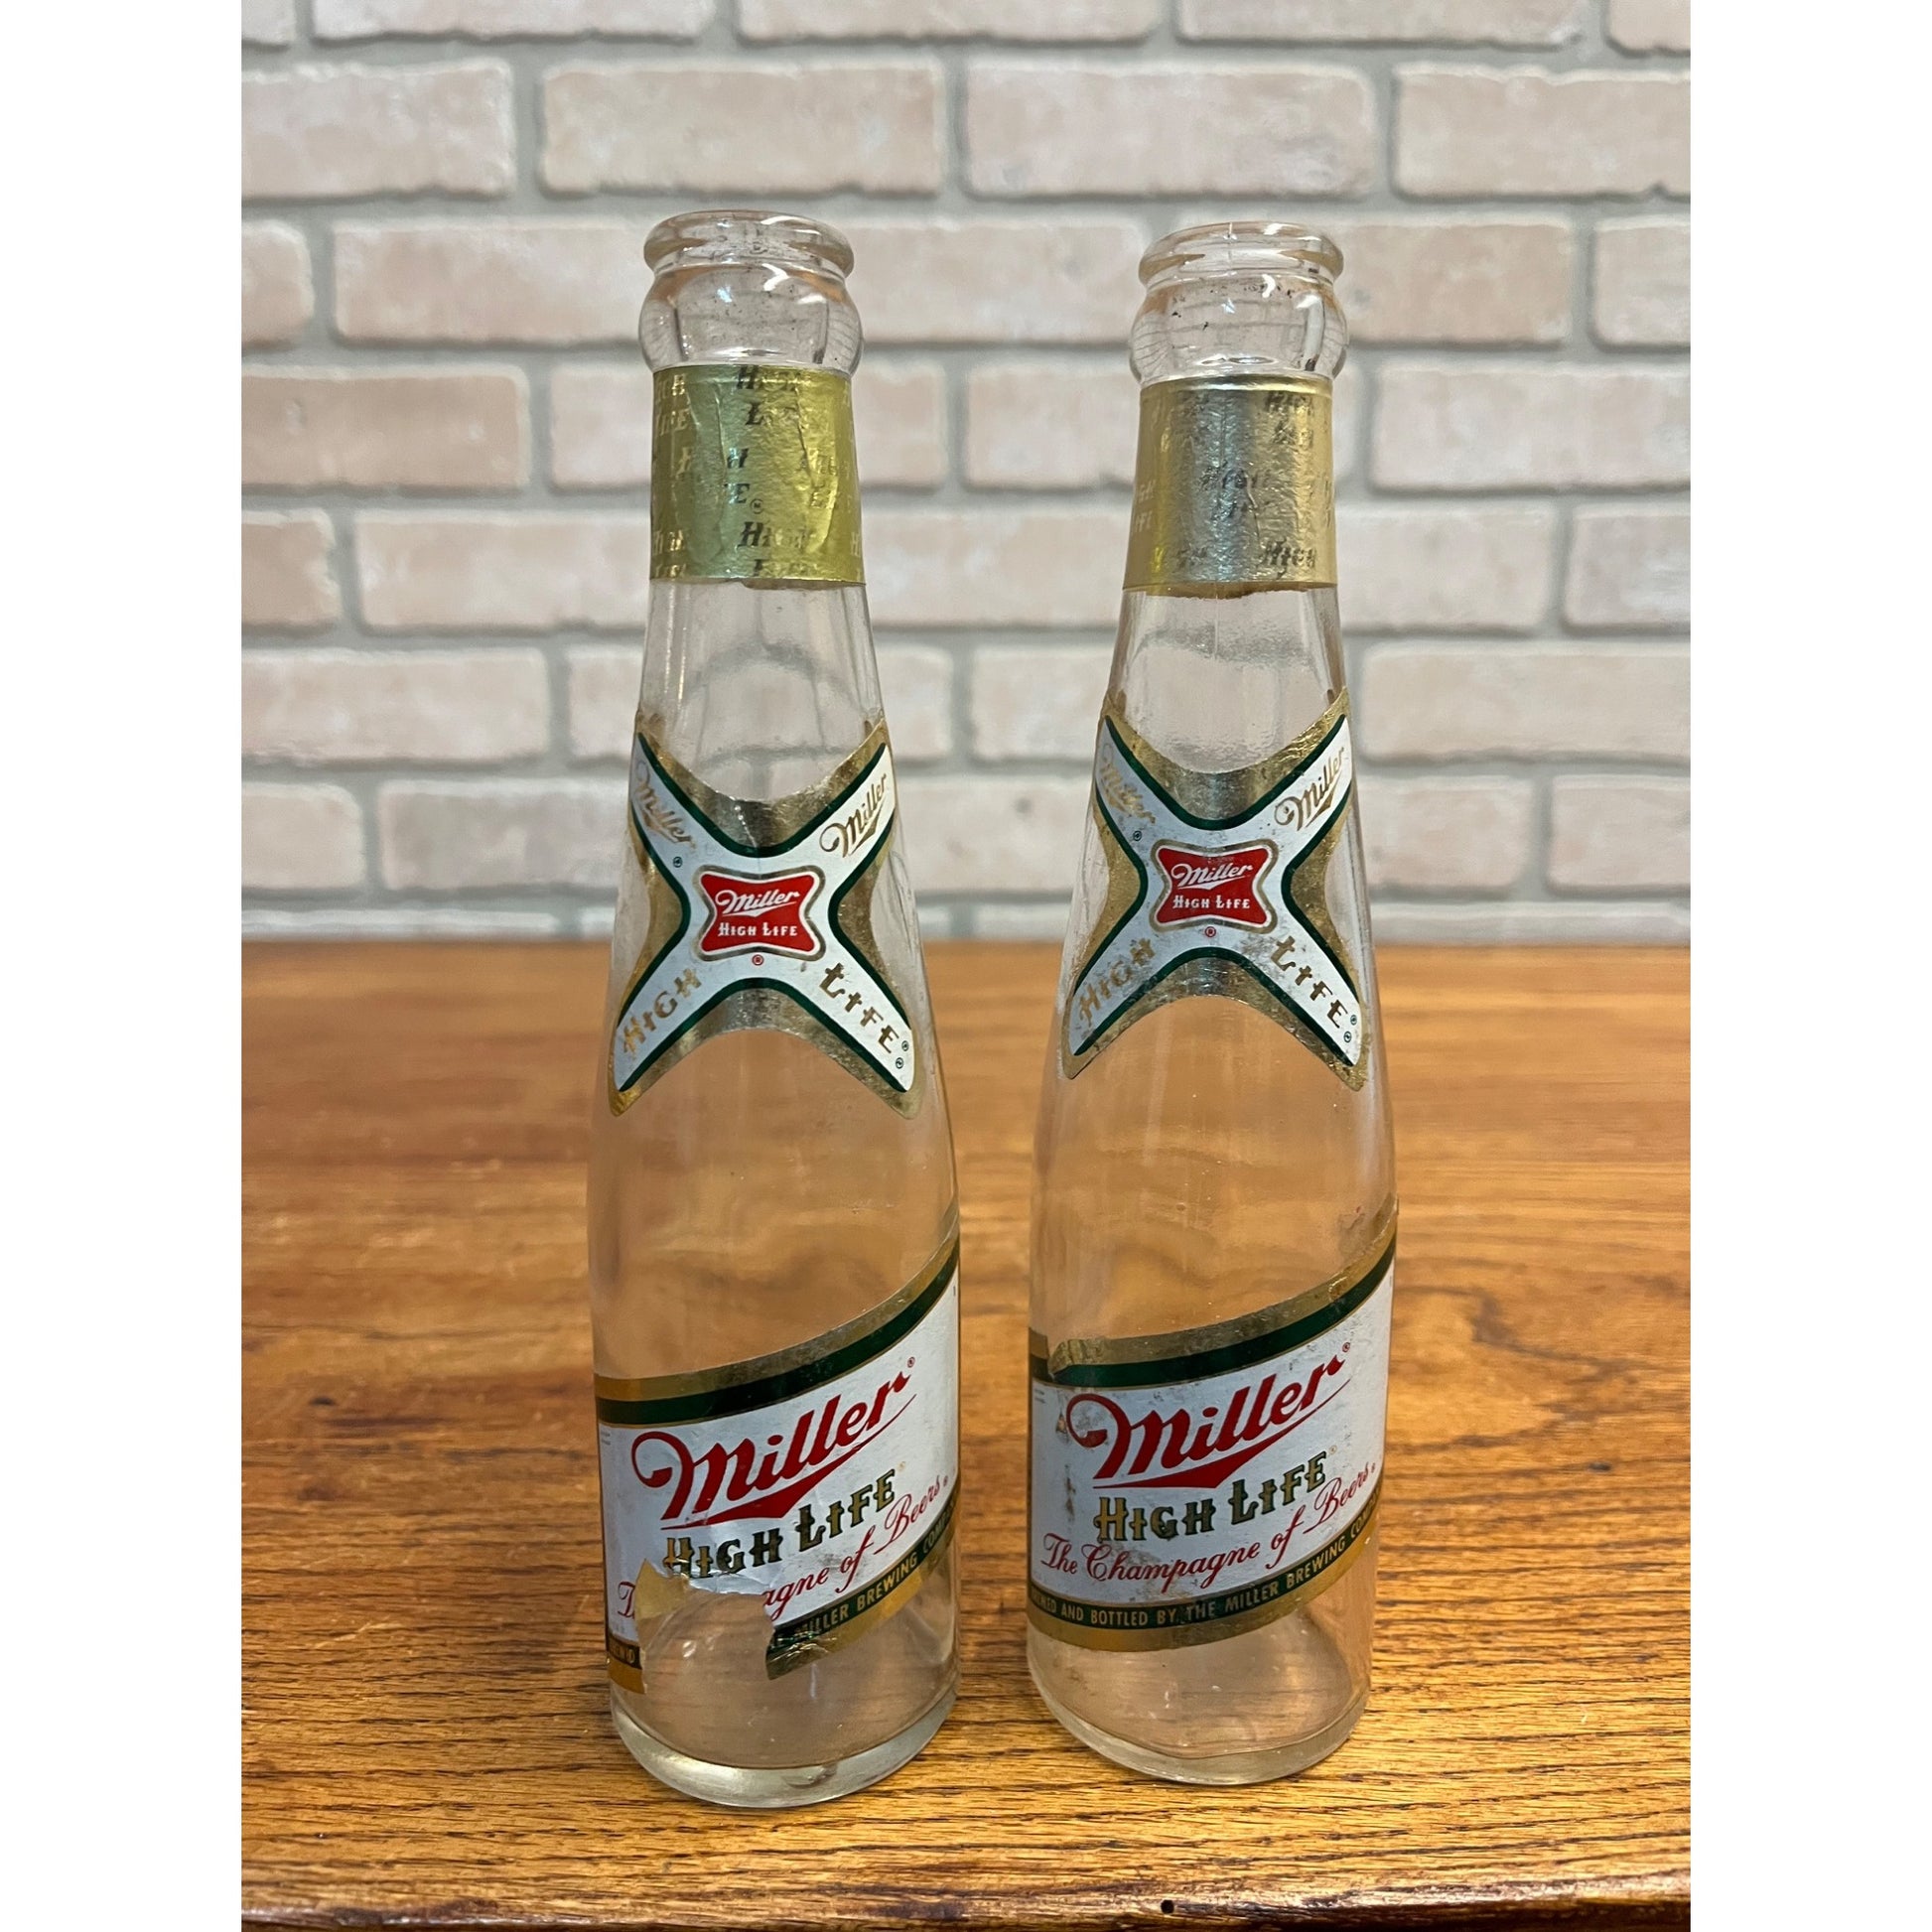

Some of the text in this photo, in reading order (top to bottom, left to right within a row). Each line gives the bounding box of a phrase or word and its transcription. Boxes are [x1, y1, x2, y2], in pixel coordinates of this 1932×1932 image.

[635, 760, 694, 847] Miller
[820, 772, 887, 858] Miller
[1274, 747, 1345, 832] Miller
[715, 889, 800, 917] Miller
[1171, 863, 1253, 890] Miller
[1173, 895, 1250, 909] HIGH LIFE
[718, 922, 798, 937] HIGH LIFE
[621, 962, 899, 1059] HIGH LIFE
[1079, 935, 1348, 1029] HIGH LIFE
[631, 1370, 916, 1530] Miller
[1066, 1355, 1350, 1488] Miller
[662, 1468, 896, 1580] HIGH LIFE
[835, 1525, 876, 1593] of
[874, 1475, 940, 1555] Beers
[1041, 1462, 1369, 1593] The Champagne of Beers
[1093, 1450, 1326, 1543] HIGH LIFE
[857, 1554, 918, 1611] BREWING
[1060, 1606, 1084, 1622] AND
[1091, 1609, 1149, 1627] BOTTLED
[1157, 1608, 1177, 1624] BY
[1186, 1600, 1216, 1622] THE
[1224, 1581, 1280, 1613] MILLER
[1286, 1536, 1346, 1589] BREWING
